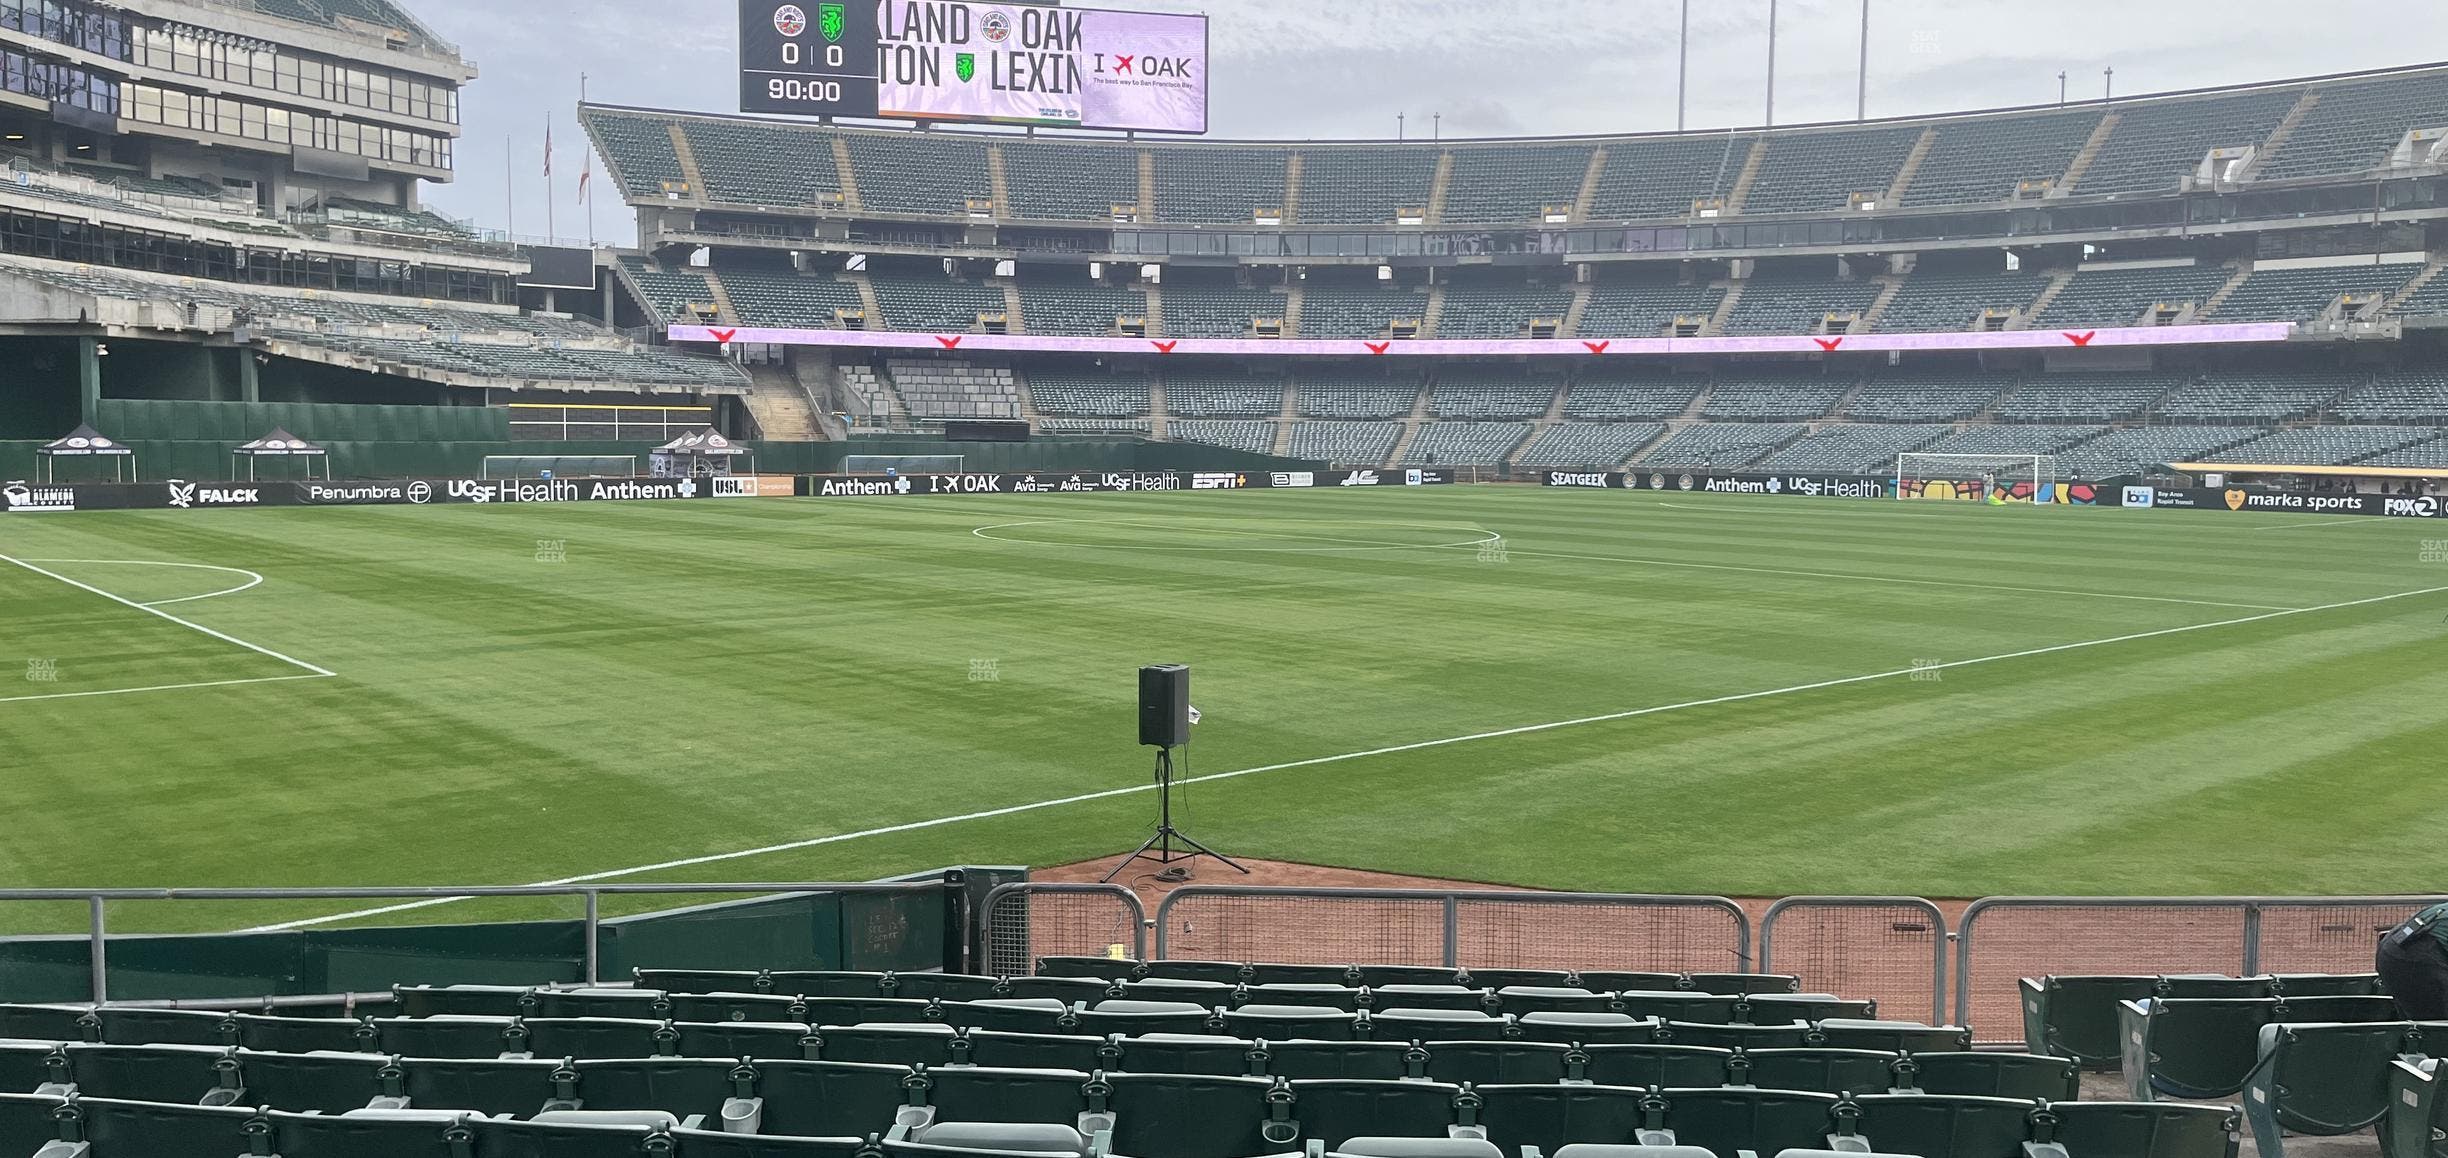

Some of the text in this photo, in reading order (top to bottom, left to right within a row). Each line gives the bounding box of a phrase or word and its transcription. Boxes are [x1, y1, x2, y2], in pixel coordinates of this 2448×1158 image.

[878, 0, 970, 44] LAND
[782, 42, 843, 67] 0 0
[1094, 53, 1192, 78] I OAK
[769, 78, 841, 102] 90:00
[715, 480, 743, 494] USL
[929, 475, 1001, 492] I OAK
[1014, 481, 1036, 492] Ava
[1060, 480, 1081, 491] Ava
[1102, 472, 1179, 491] UCSF Health
[1550, 472, 1608, 487] SEATGEEK
[1705, 478, 1764, 493] Anthem
[1789, 478, 1882, 498] UCSF Health
[199, 488, 259, 503] FALCK
[311, 485, 402, 499] Penumbra
[448, 479, 578, 503] UCSF Health
[2248, 493, 2362, 511] marka sports
